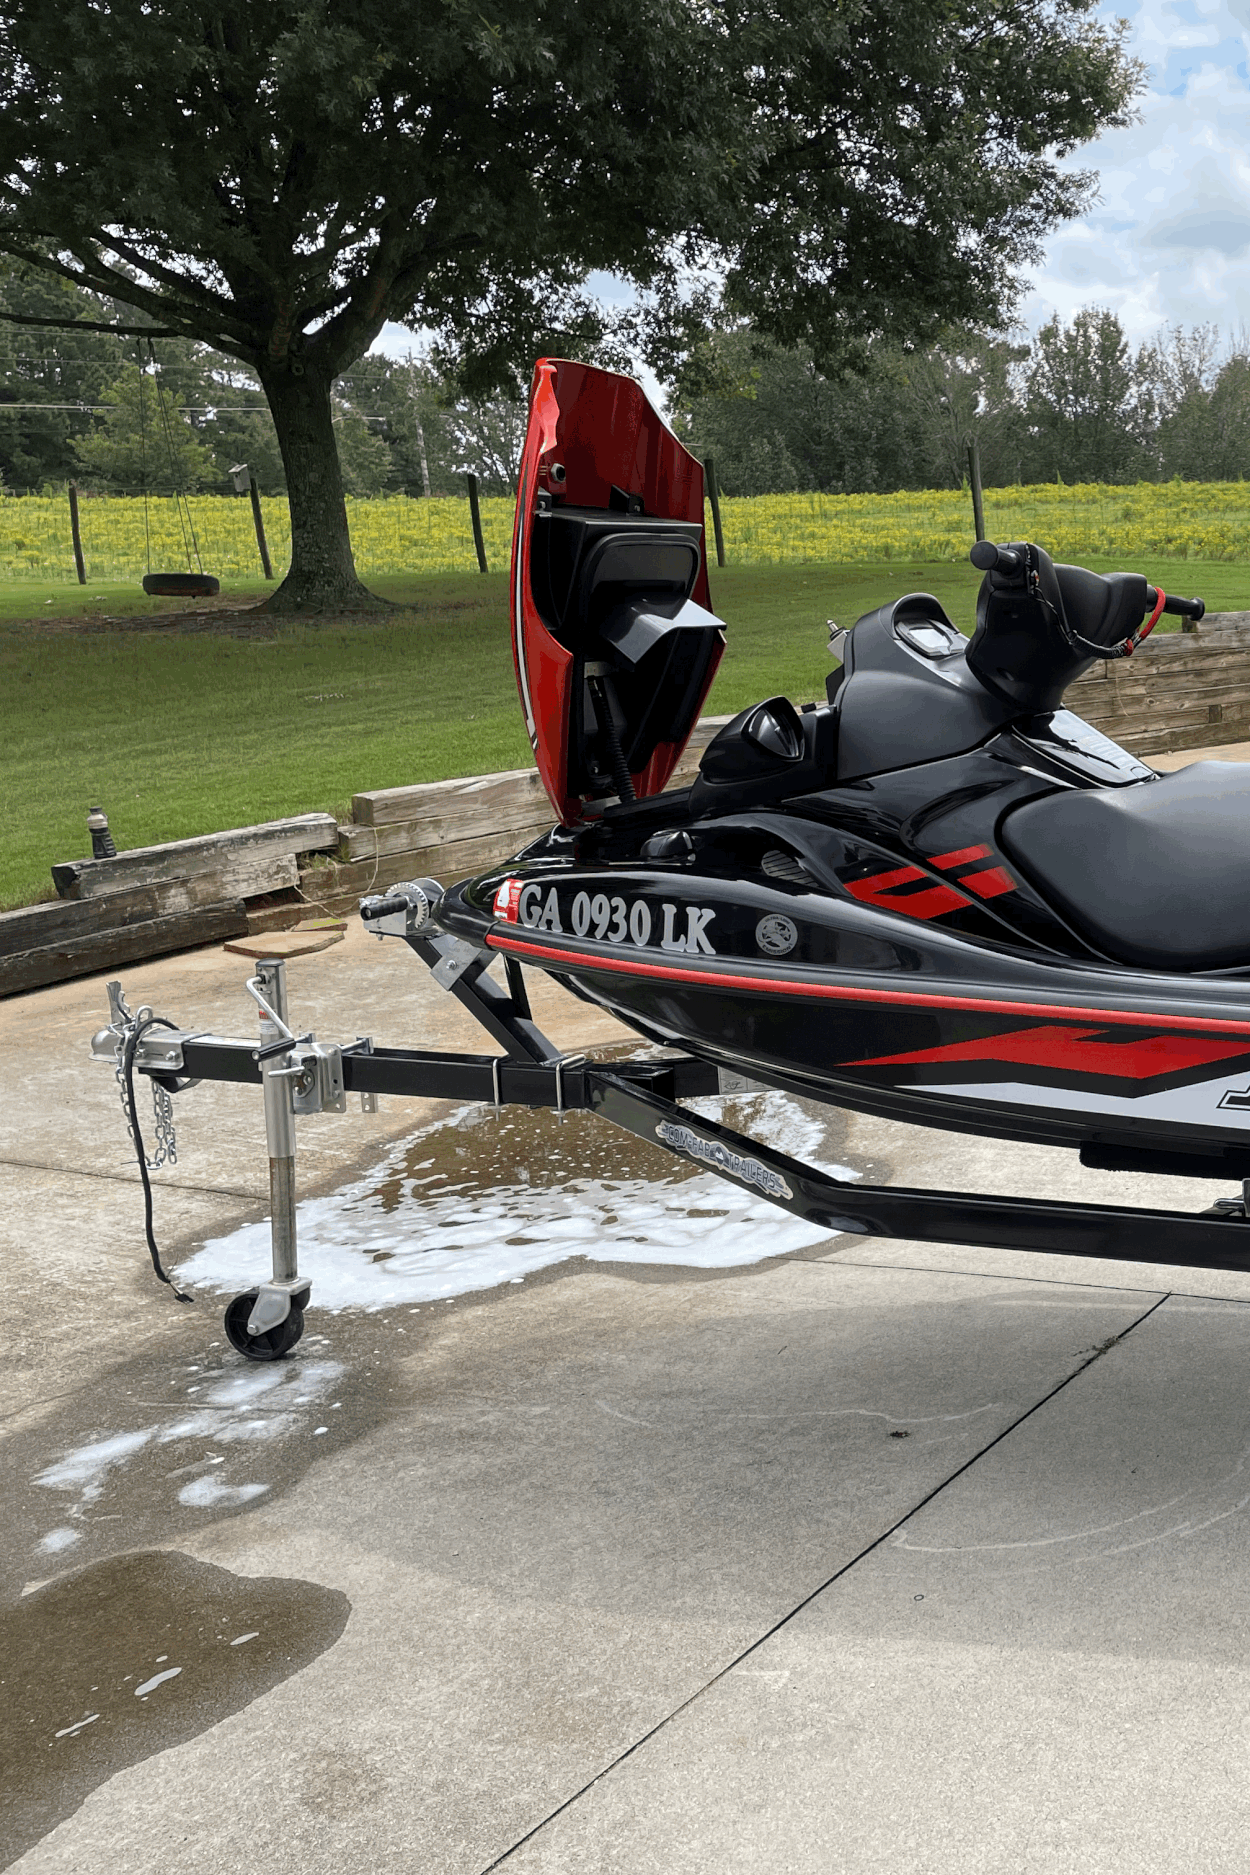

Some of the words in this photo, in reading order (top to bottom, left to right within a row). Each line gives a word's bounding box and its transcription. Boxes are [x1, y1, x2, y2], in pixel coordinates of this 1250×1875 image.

[518, 884, 563, 932] GA
[571, 891, 651, 946] 0930
[661, 903, 716, 955] LK
[668, 1125, 711, 1158] COM-FAB
[728, 1152, 777, 1189] TRAILERS
